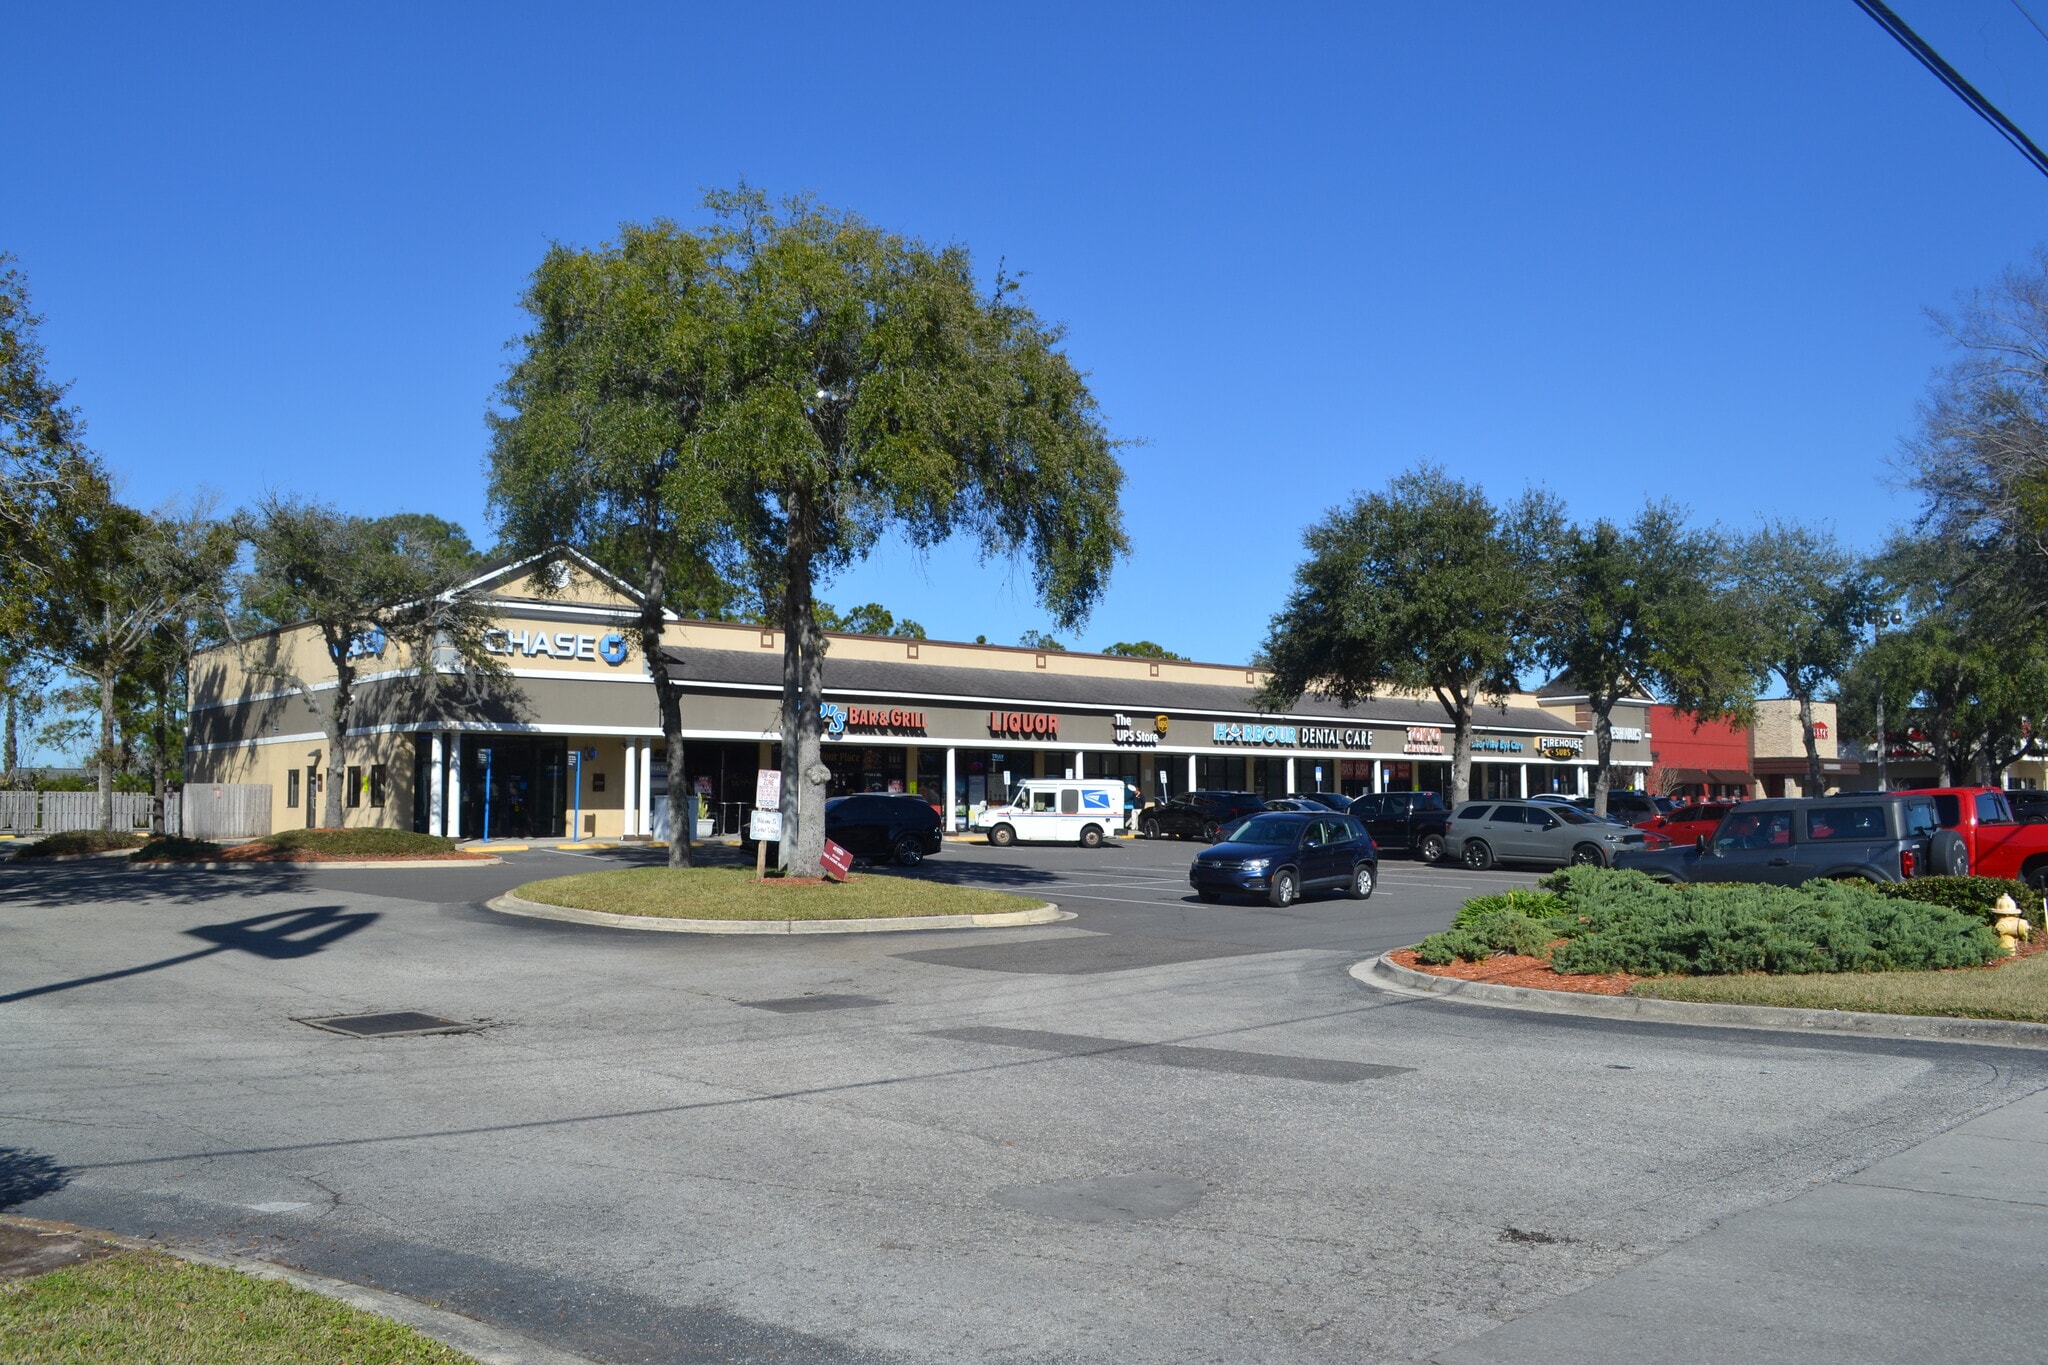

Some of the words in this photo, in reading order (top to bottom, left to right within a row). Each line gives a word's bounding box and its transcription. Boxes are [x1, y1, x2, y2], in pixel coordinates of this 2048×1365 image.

[483, 629, 596, 659] CHASE
[991, 712, 1059, 733] LIQUOR
[1115, 714, 1132, 726] The
[1117, 729, 1134, 742] UPS
[1136, 731, 1159, 743] Store
[1213, 723, 1297, 744] HARBOUR
[1302, 728, 1341, 745] DENTAL
[1345, 730, 1373, 746] CARE
[1407, 727, 1442, 742] TOKYO
[1541, 737, 1583, 752] FIREHOUSE
[1555, 749, 1571, 757] SUBS
